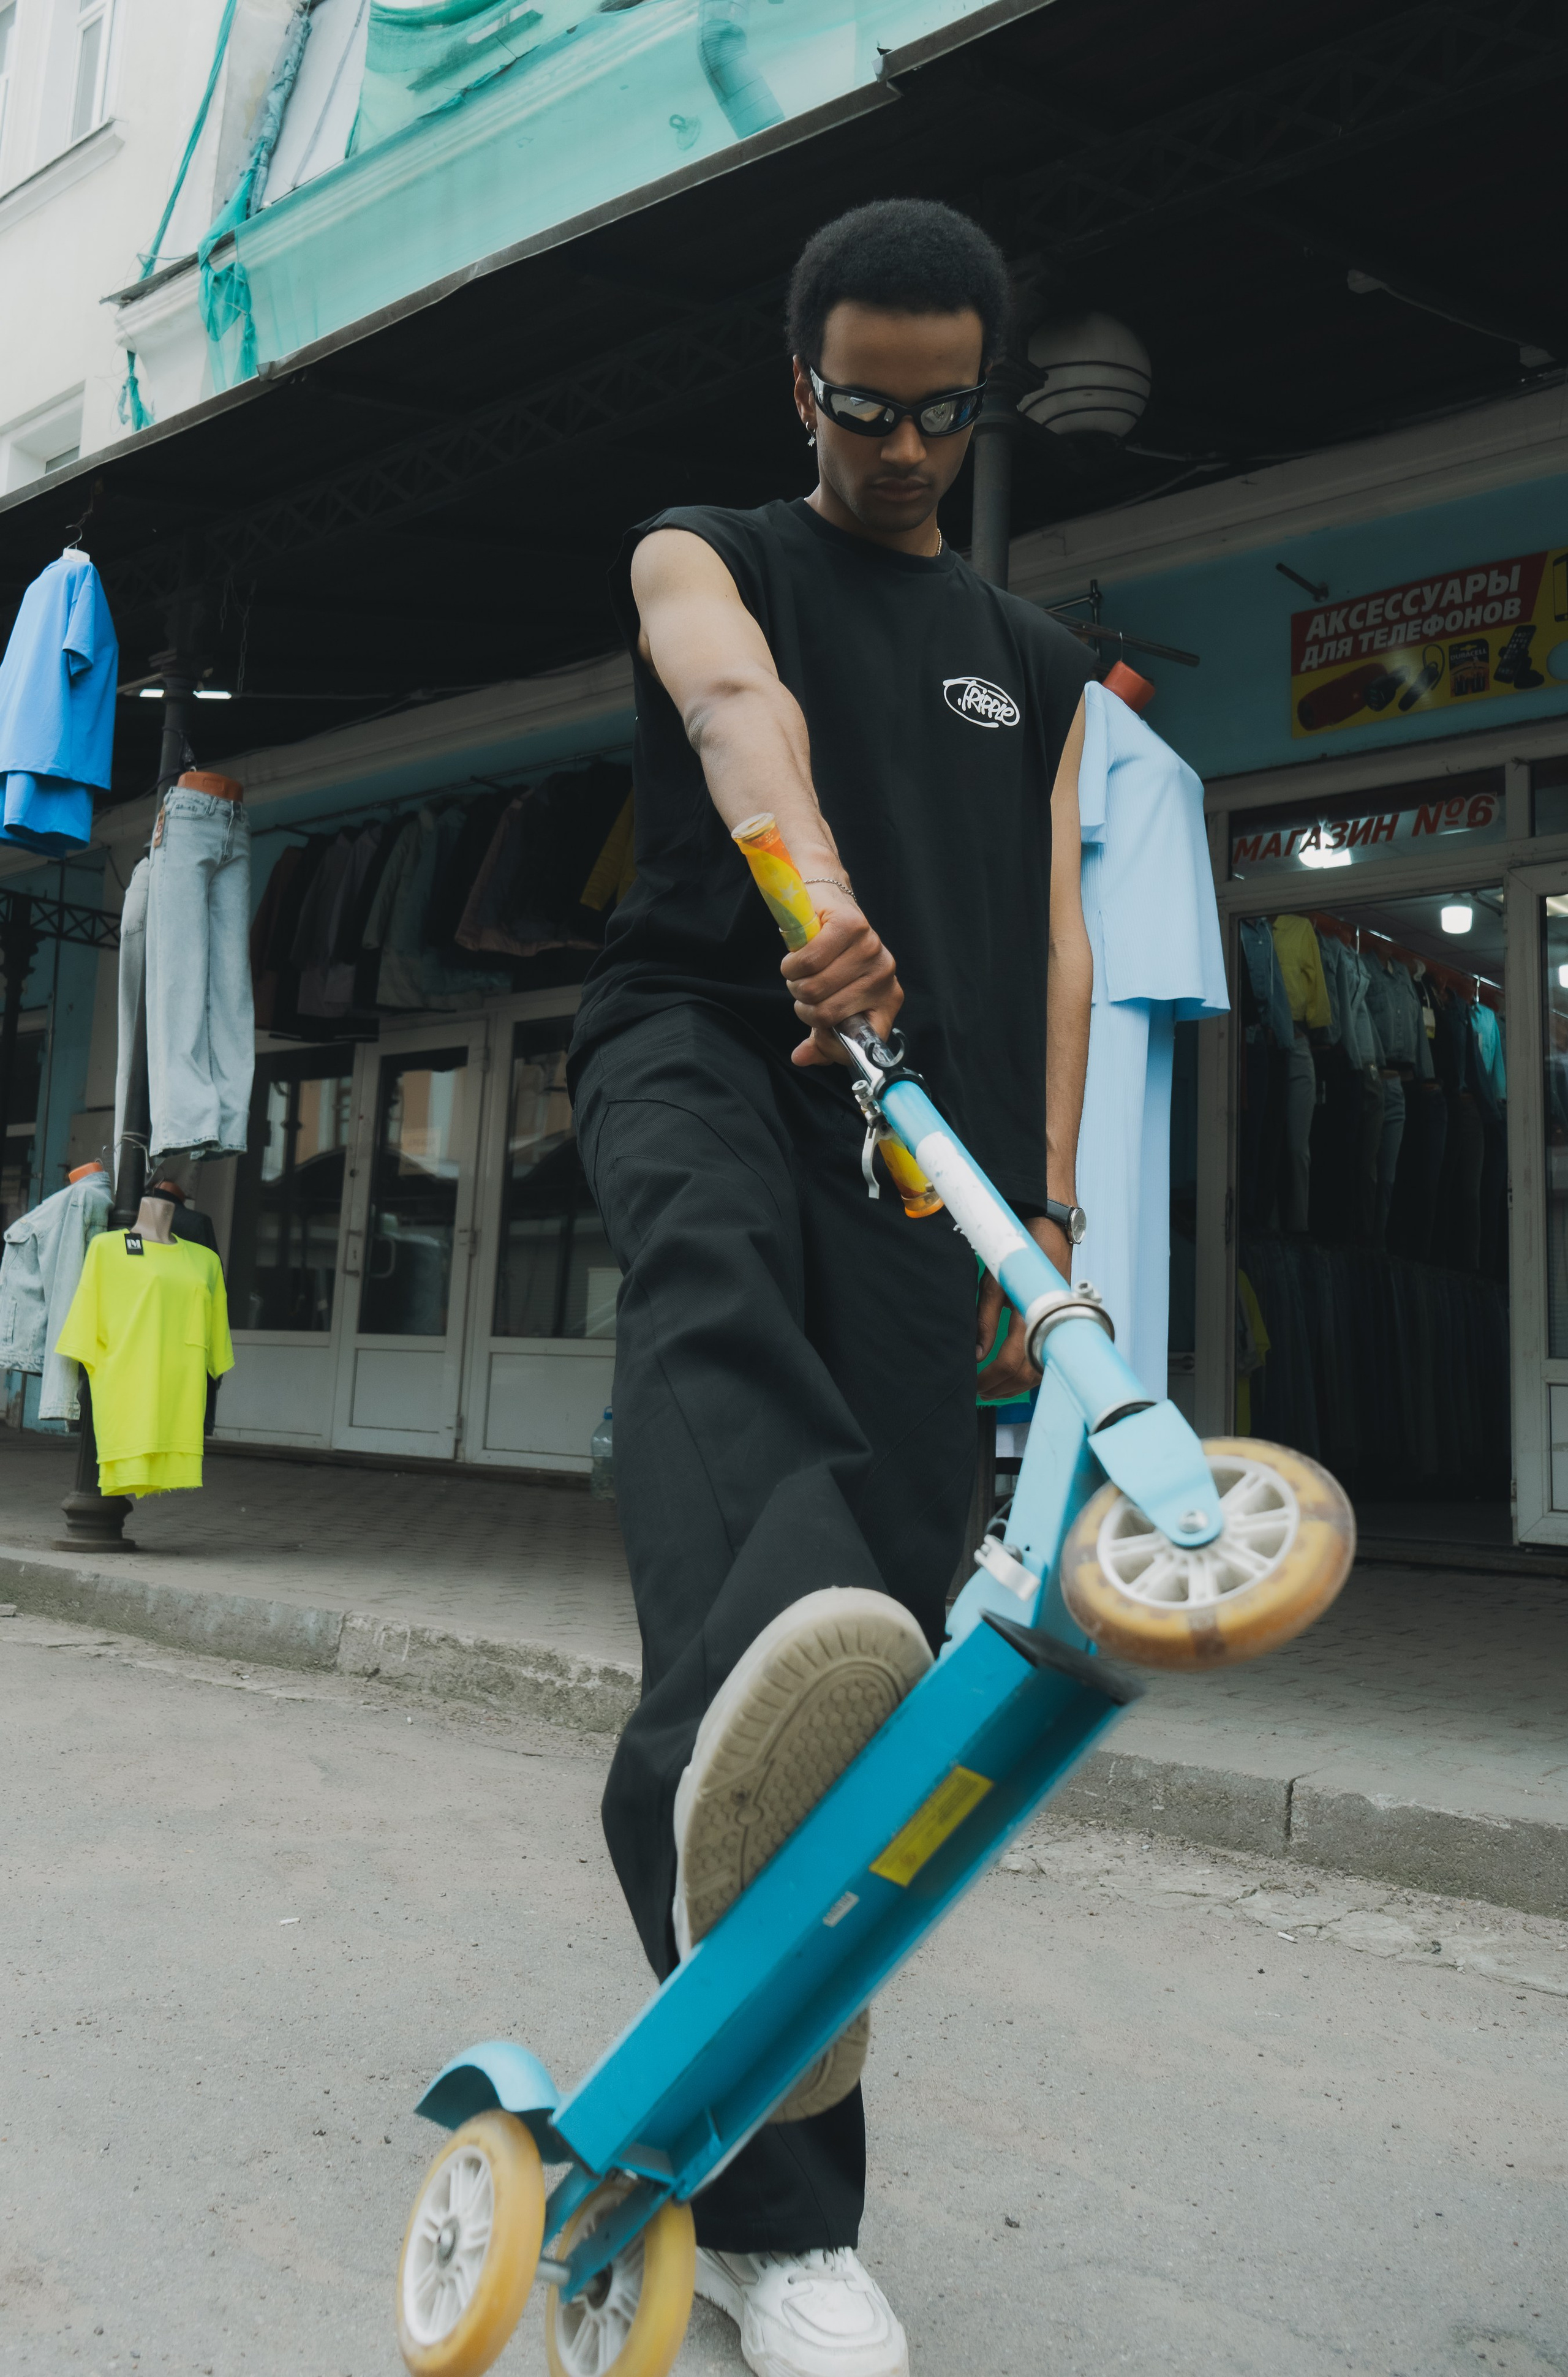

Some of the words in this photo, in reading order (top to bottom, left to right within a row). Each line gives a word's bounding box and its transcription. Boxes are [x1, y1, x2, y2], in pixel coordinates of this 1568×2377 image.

[1300, 636, 1352, 672] ДЛЯ
[1358, 597, 1522, 654] ТЕЛЕФОНОВ
[1305, 564, 1521, 642] АКСЕССУАРЫ
[1450, 647, 1487, 661] DURACELL
[1232, 813, 1400, 865] МАГАЗИН
